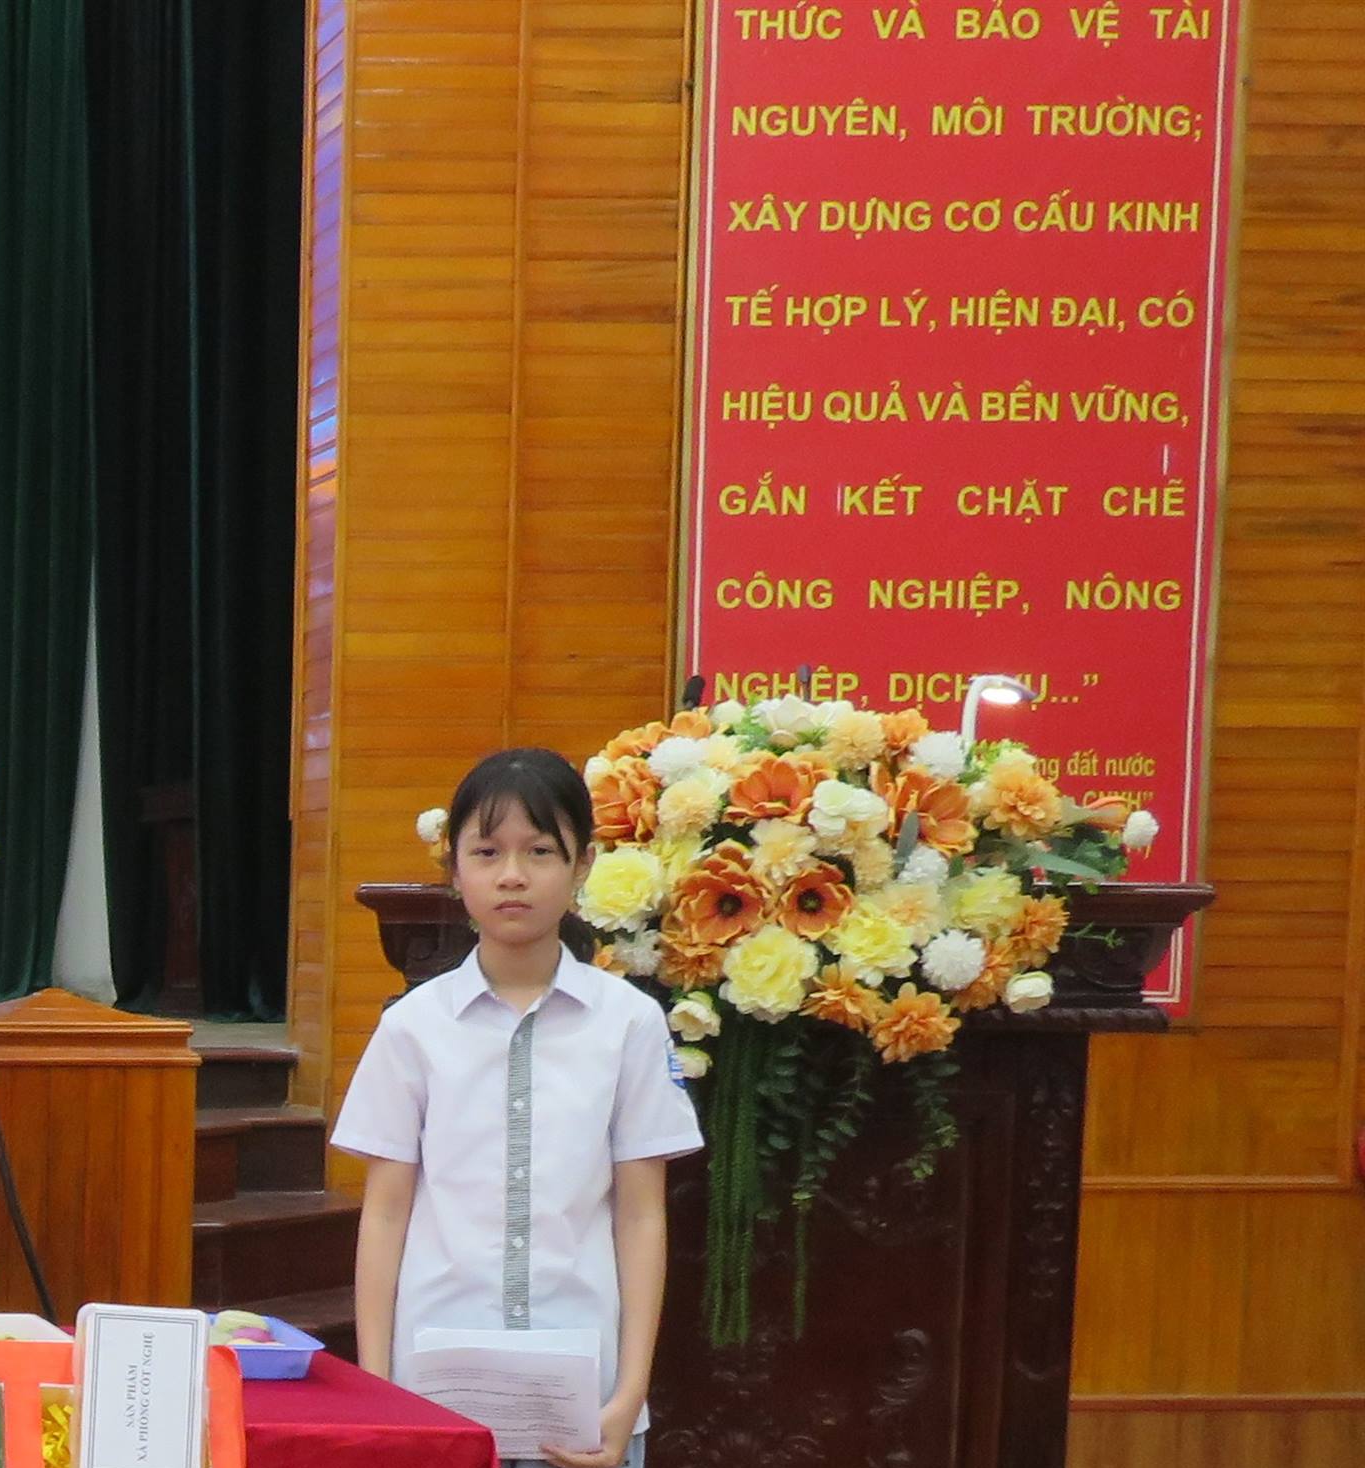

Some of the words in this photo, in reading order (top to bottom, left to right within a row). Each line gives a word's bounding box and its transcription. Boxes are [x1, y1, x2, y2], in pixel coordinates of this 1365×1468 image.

[735, 2, 843, 40] THỨC
[873, 1, 925, 39] VÀ
[955, 0, 1040, 40] BẢO
[1069, 4, 1120, 47] VỆ
[1150, 0, 1210, 40] TÀI
[731, 98, 907, 141] NGUYÊN,
[931, 98, 1004, 136] MÔI
[1027, 96, 1203, 142] TRƯỜNG;
[728, 195, 808, 232] XÂY
[819, 199, 931, 240] DỰNG
[945, 199, 1004, 233] CƠ
[1013, 190, 1094, 232] CẤU
[1107, 201, 1200, 232] KINH
[726, 284, 780, 327] TẾ
[785, 295, 867, 335] HỢP
[878, 289, 937, 332] LÝ,
[949, 290, 1040, 335] HIỆN
[1050, 296, 1126, 335] ĐẠI,
[1138, 289, 1195, 328] CÓ
[721, 386, 811, 430] HIỆU
[823, 382, 907, 428] QUẢ
[918, 382, 970, 421] VÀ
[980, 381, 1059, 422] BỀN
[1069, 384, 1189, 427] VỮNG,
[719, 472, 807, 515] GẮN
[843, 474, 922, 515] KẾT
[957, 481, 1068, 523] CHẶT
[1102, 480, 1185, 516] CHẼ
[716, 573, 834, 610] CÔNG
[869, 575, 1031, 618] NGHIỆP,
[1065, 573, 1182, 611] NÔNG
